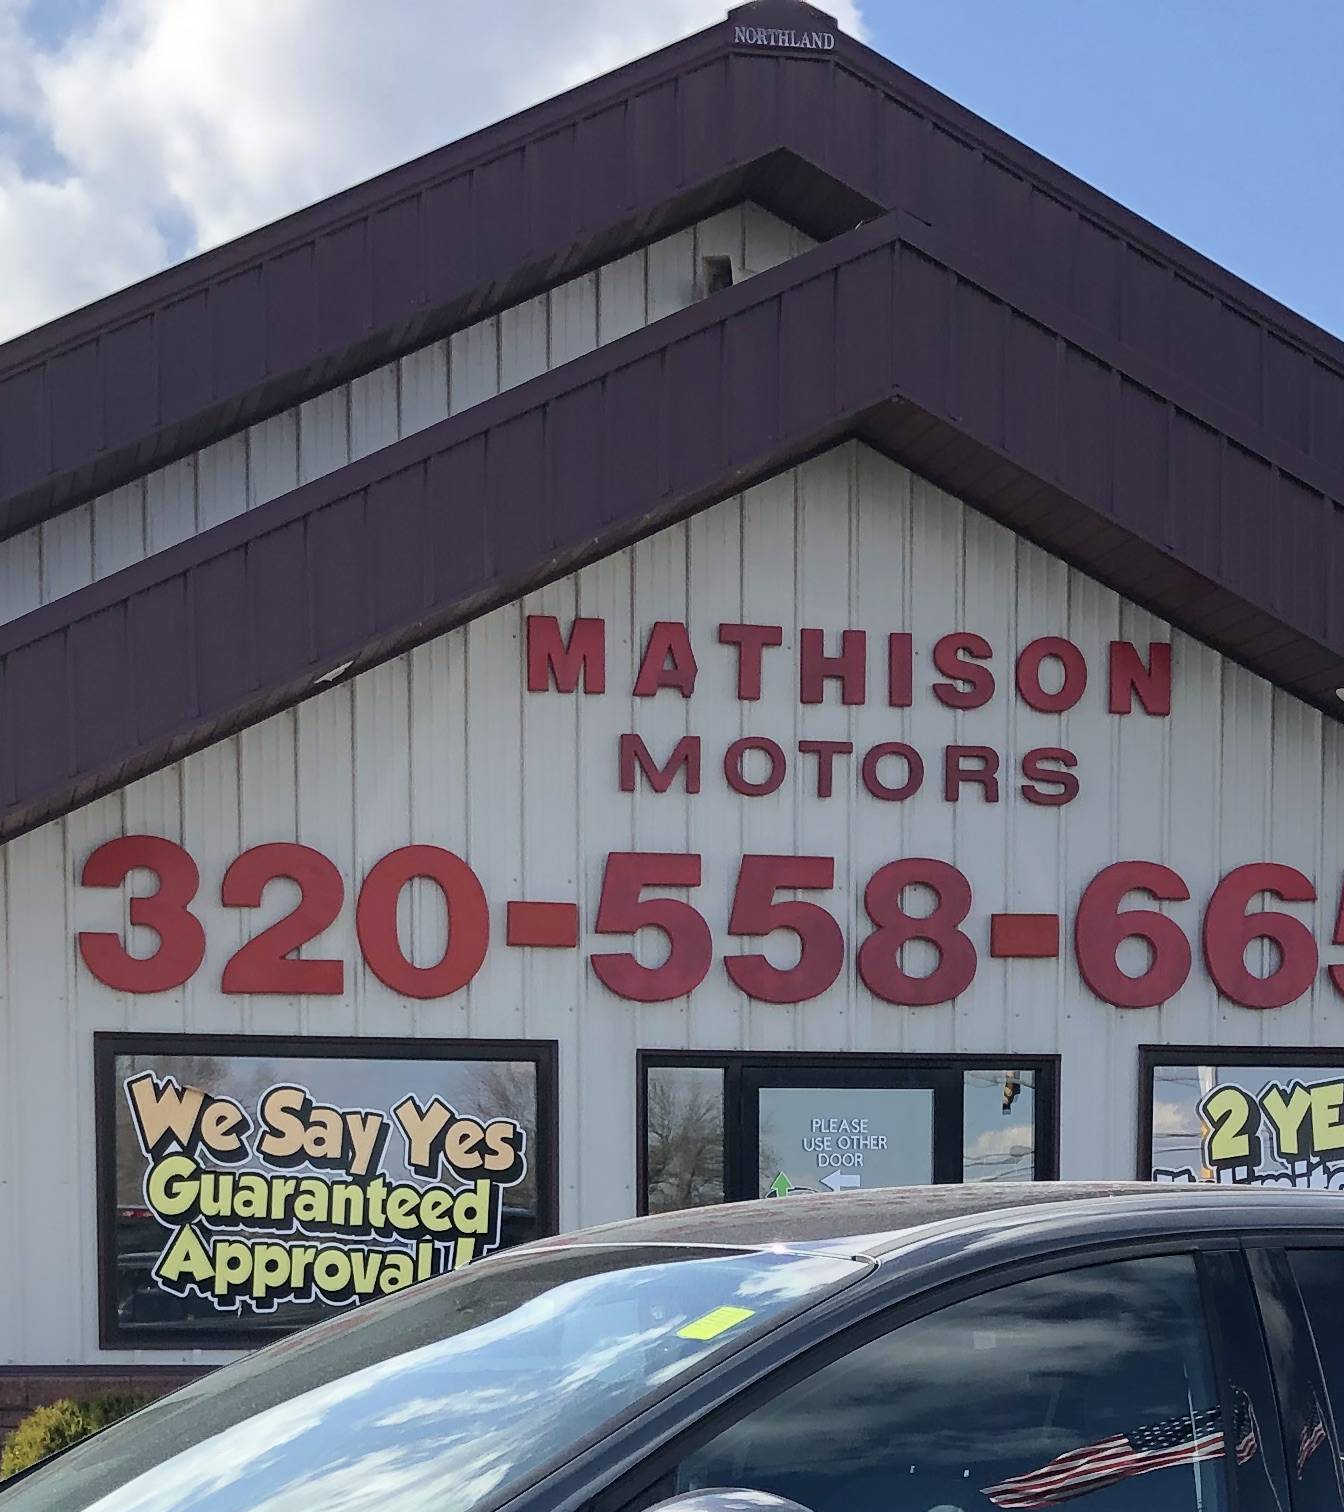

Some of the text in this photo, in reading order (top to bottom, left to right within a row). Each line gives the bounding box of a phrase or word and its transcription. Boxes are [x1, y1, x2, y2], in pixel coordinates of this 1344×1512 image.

[734, 26, 836, 50] NORTHLAND
[526, 614, 1173, 717] MATHISON
[619, 733, 1081, 807] MOTORS
[125, 1073, 522, 1177] We Say Yes
[803, 1135, 888, 1151] USE OTHER
[811, 1118, 869, 1134] PLEASE
[817, 1152, 864, 1167] DOOR
[1205, 1087, 1256, 1163] 2
[147, 1154, 491, 1235] Guaranteed
